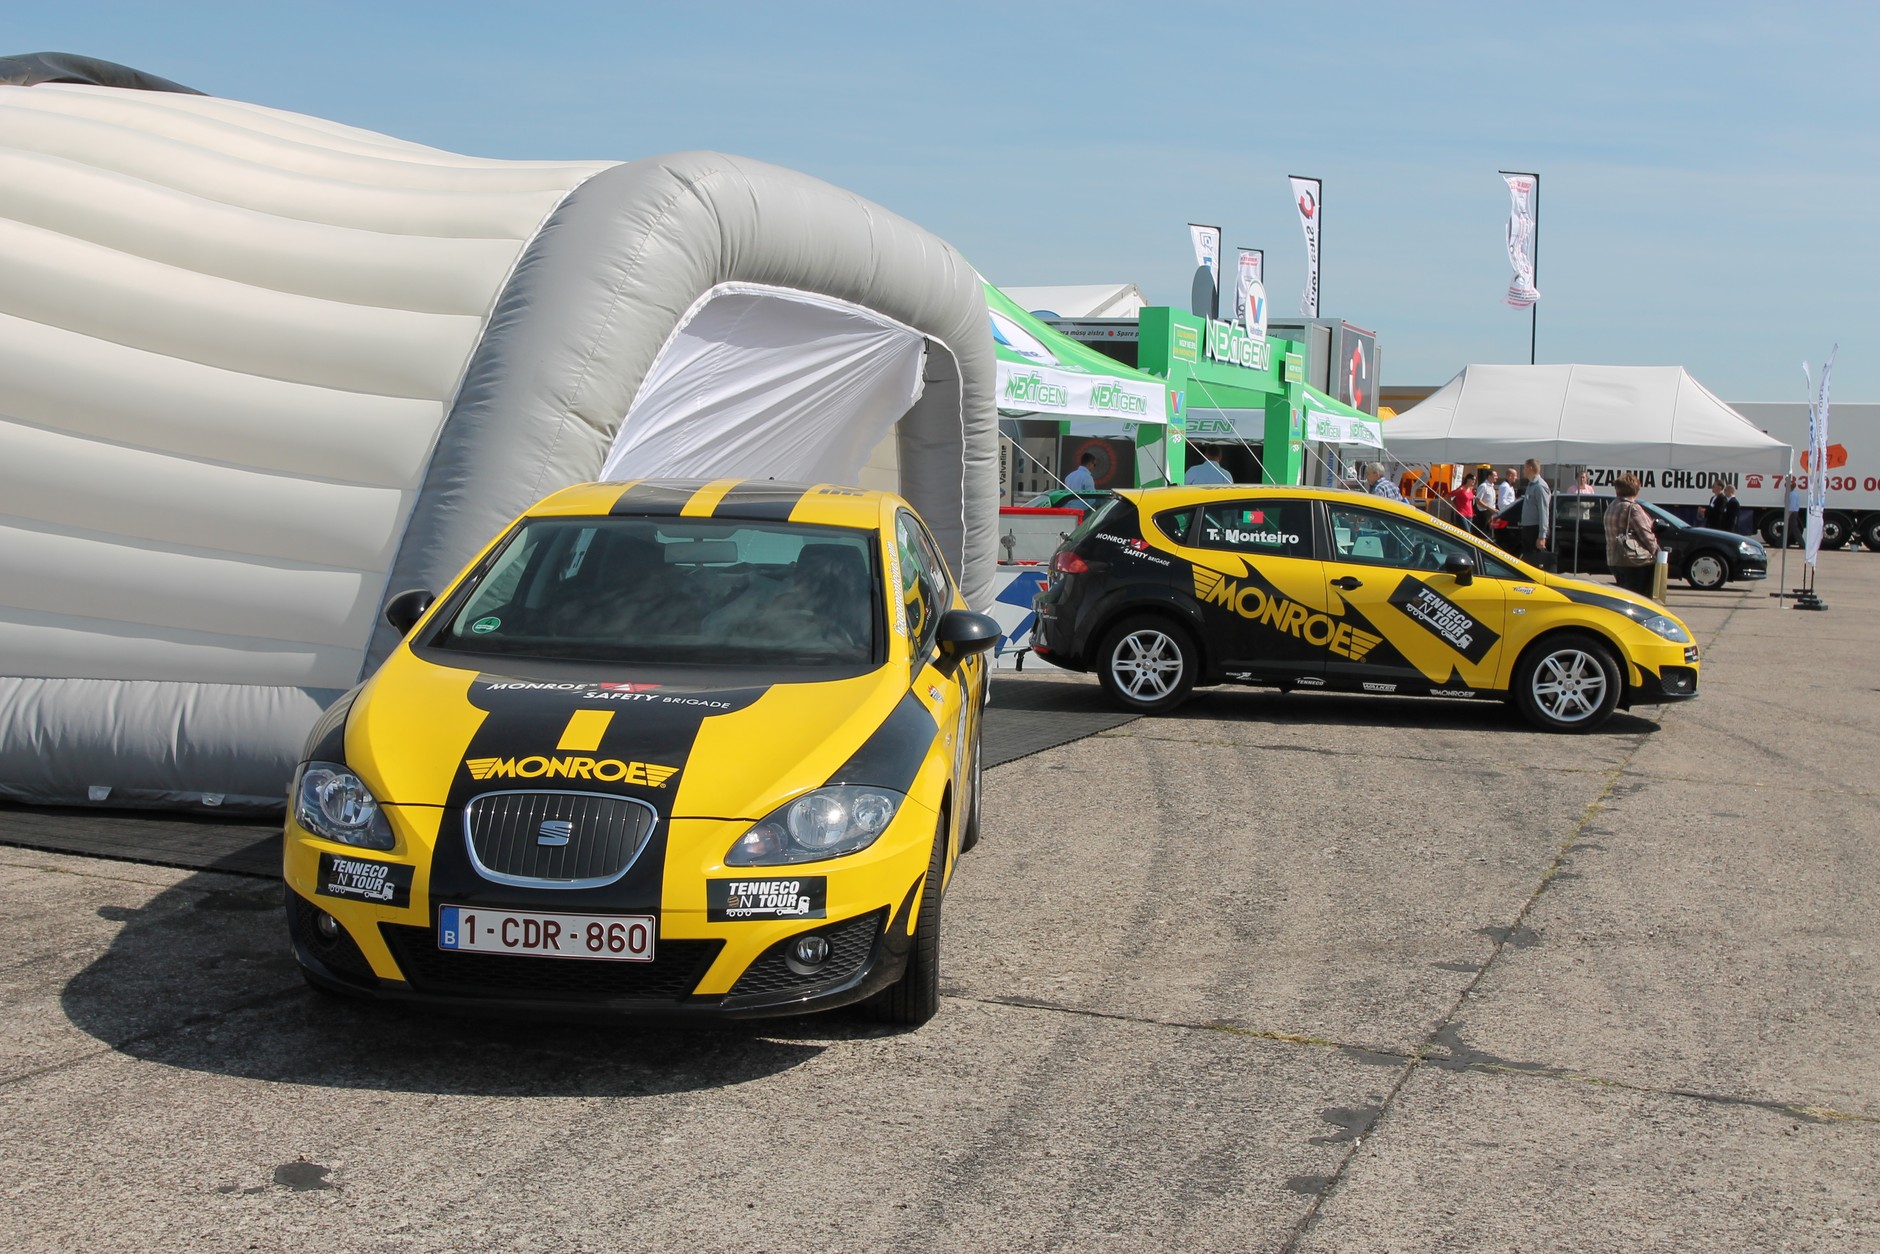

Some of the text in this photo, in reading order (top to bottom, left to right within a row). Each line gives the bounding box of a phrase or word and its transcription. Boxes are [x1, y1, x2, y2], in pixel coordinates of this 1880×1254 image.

[1205, 314, 1271, 371] NEXTGEN
[1004, 369, 1068, 406] NEXTGEN
[1088, 380, 1147, 415] NEXTGEN
[1661, 470, 1739, 490] CHŁODNI
[1095, 532, 1128, 545] MONROE
[1225, 528, 1300, 545] Monteiro
[1123, 548, 1171, 567] SAFETY BRIGADE
[1205, 576, 1354, 660] MONROE
[1418, 588, 1473, 629] TENNECO
[1432, 611, 1465, 638] TOUR
[486, 682, 589, 691] MONROE
[1363, 683, 1396, 692] WALKER
[1436, 689, 1470, 697] MONROE
[583, 691, 731, 710] SAFETY BRIGADE
[485, 754, 648, 786] MONROE
[332, 859, 389, 879] TENNECO
[351, 875, 385, 891] TOUR
[729, 881, 801, 895] TENNECO
[758, 894, 798, 908] TOUR
[444, 929, 456, 946] B
